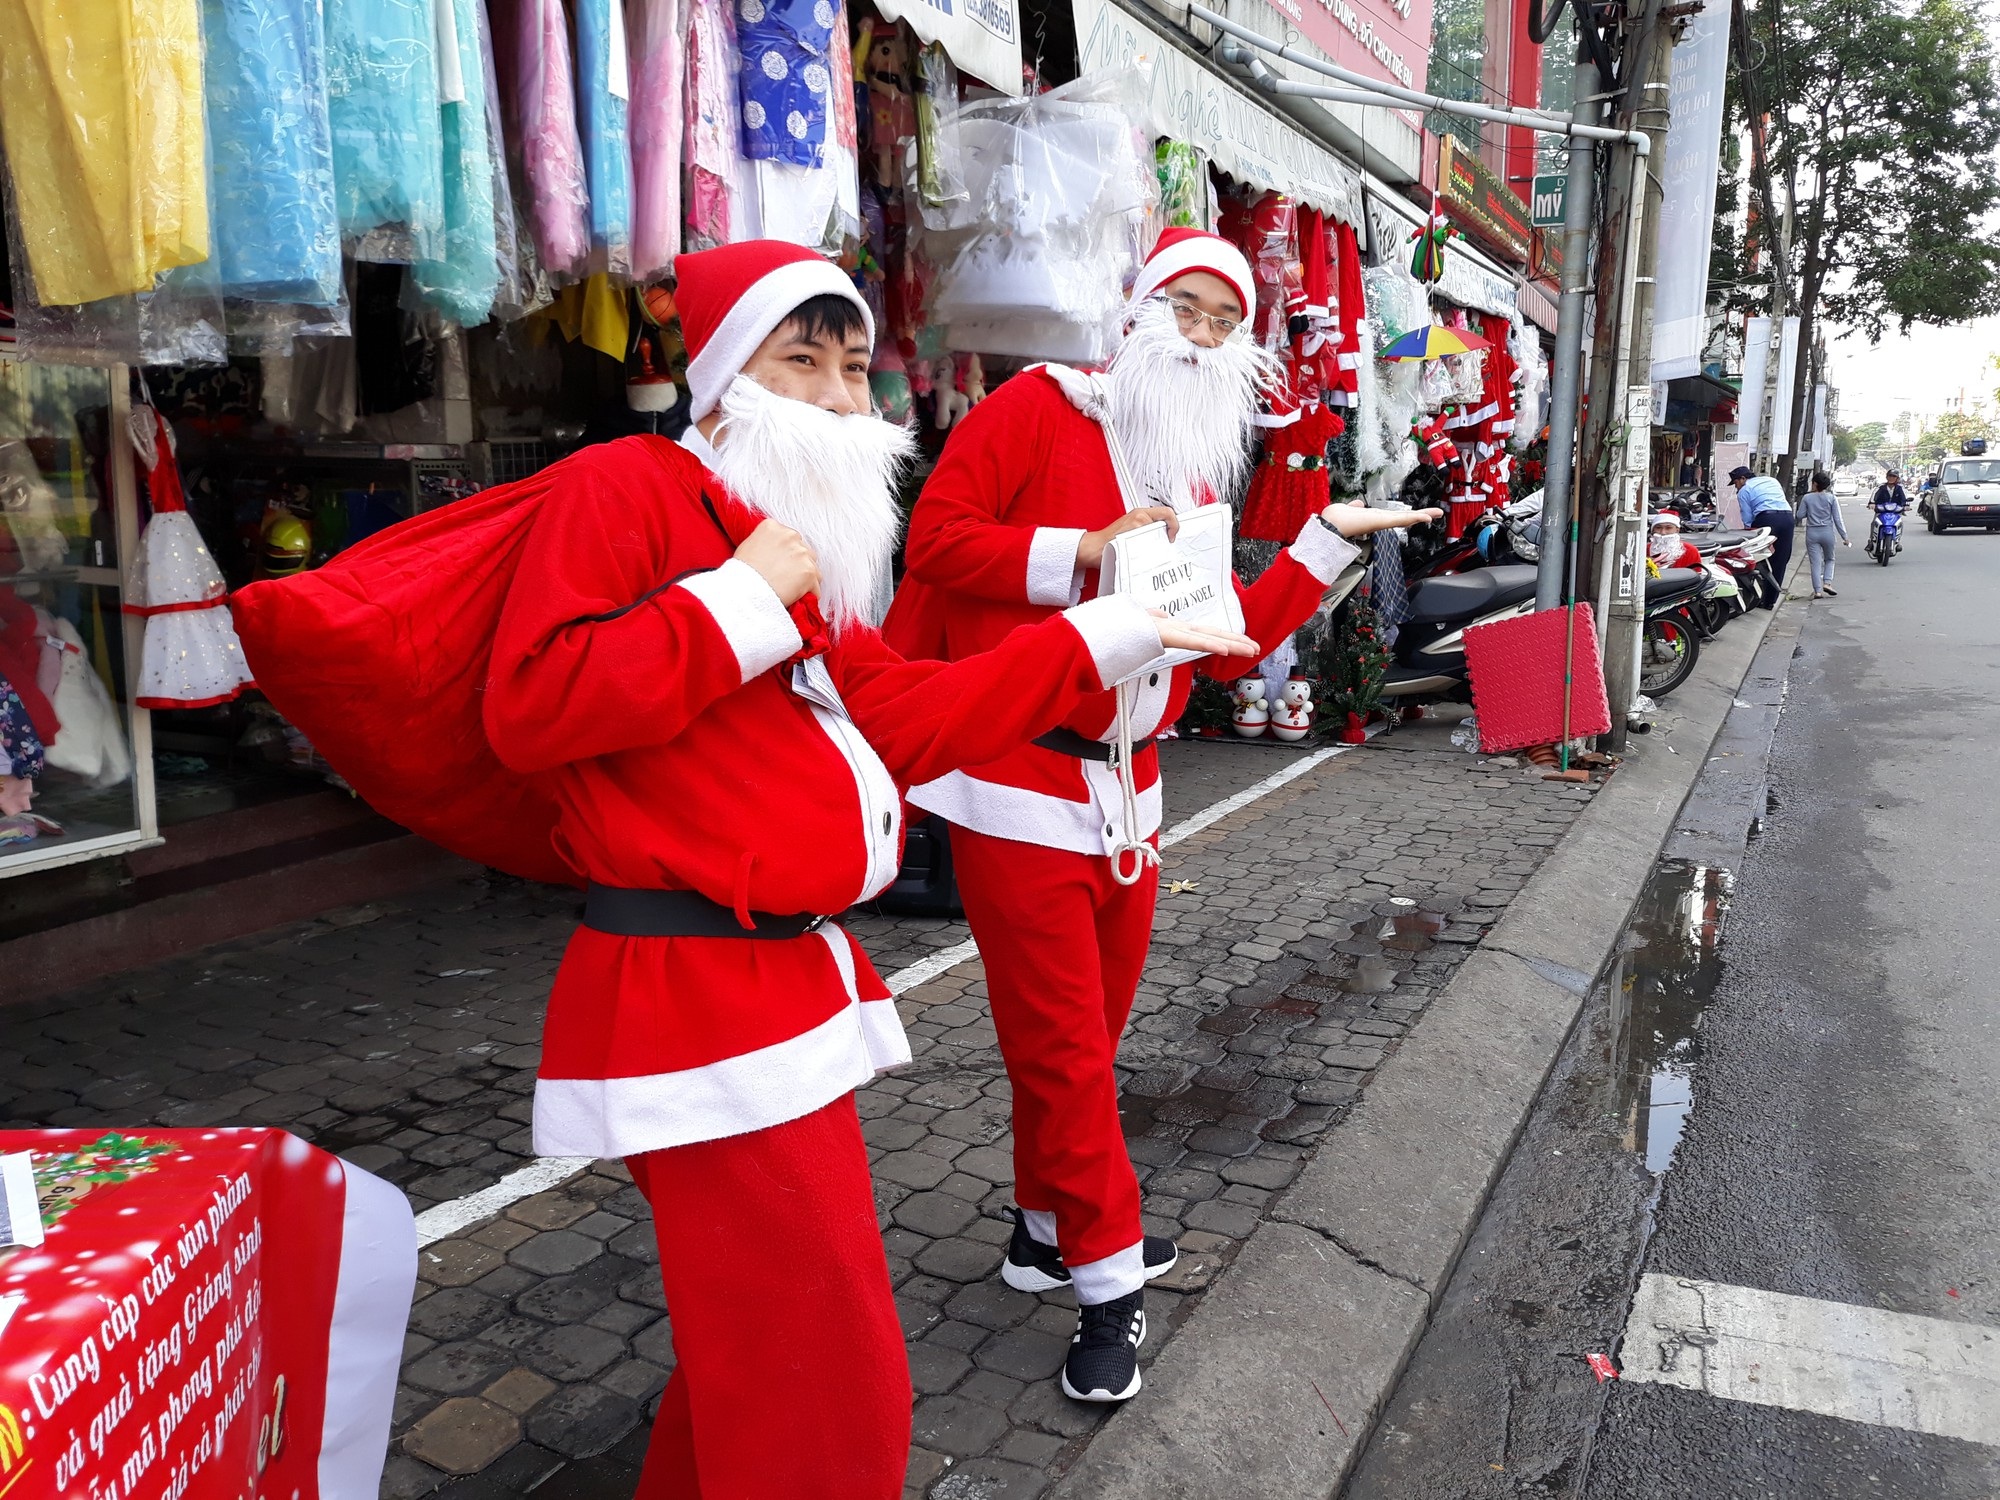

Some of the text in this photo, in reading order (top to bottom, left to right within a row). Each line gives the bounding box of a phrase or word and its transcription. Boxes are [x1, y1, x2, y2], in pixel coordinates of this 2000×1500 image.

[1535, 187, 1563, 218] MỸ
[1152, 561, 1193, 592] DỊCH VỤ
[28, 1336, 99, 1419] Cung
[142, 1254, 176, 1306] các
[177, 1219, 209, 1269] sản
[56, 1429, 86, 1493] và
[89, 1372, 134, 1461] quà
[137, 1321, 181, 1395] tặng
[184, 1260, 232, 1345] Giáng
[234, 1216, 262, 1275] sinh
[122, 1422, 156, 1497] mã
[159, 1355, 213, 1461] phong
[216, 1304, 243, 1383] phú
[192, 1421, 213, 1475] cả
